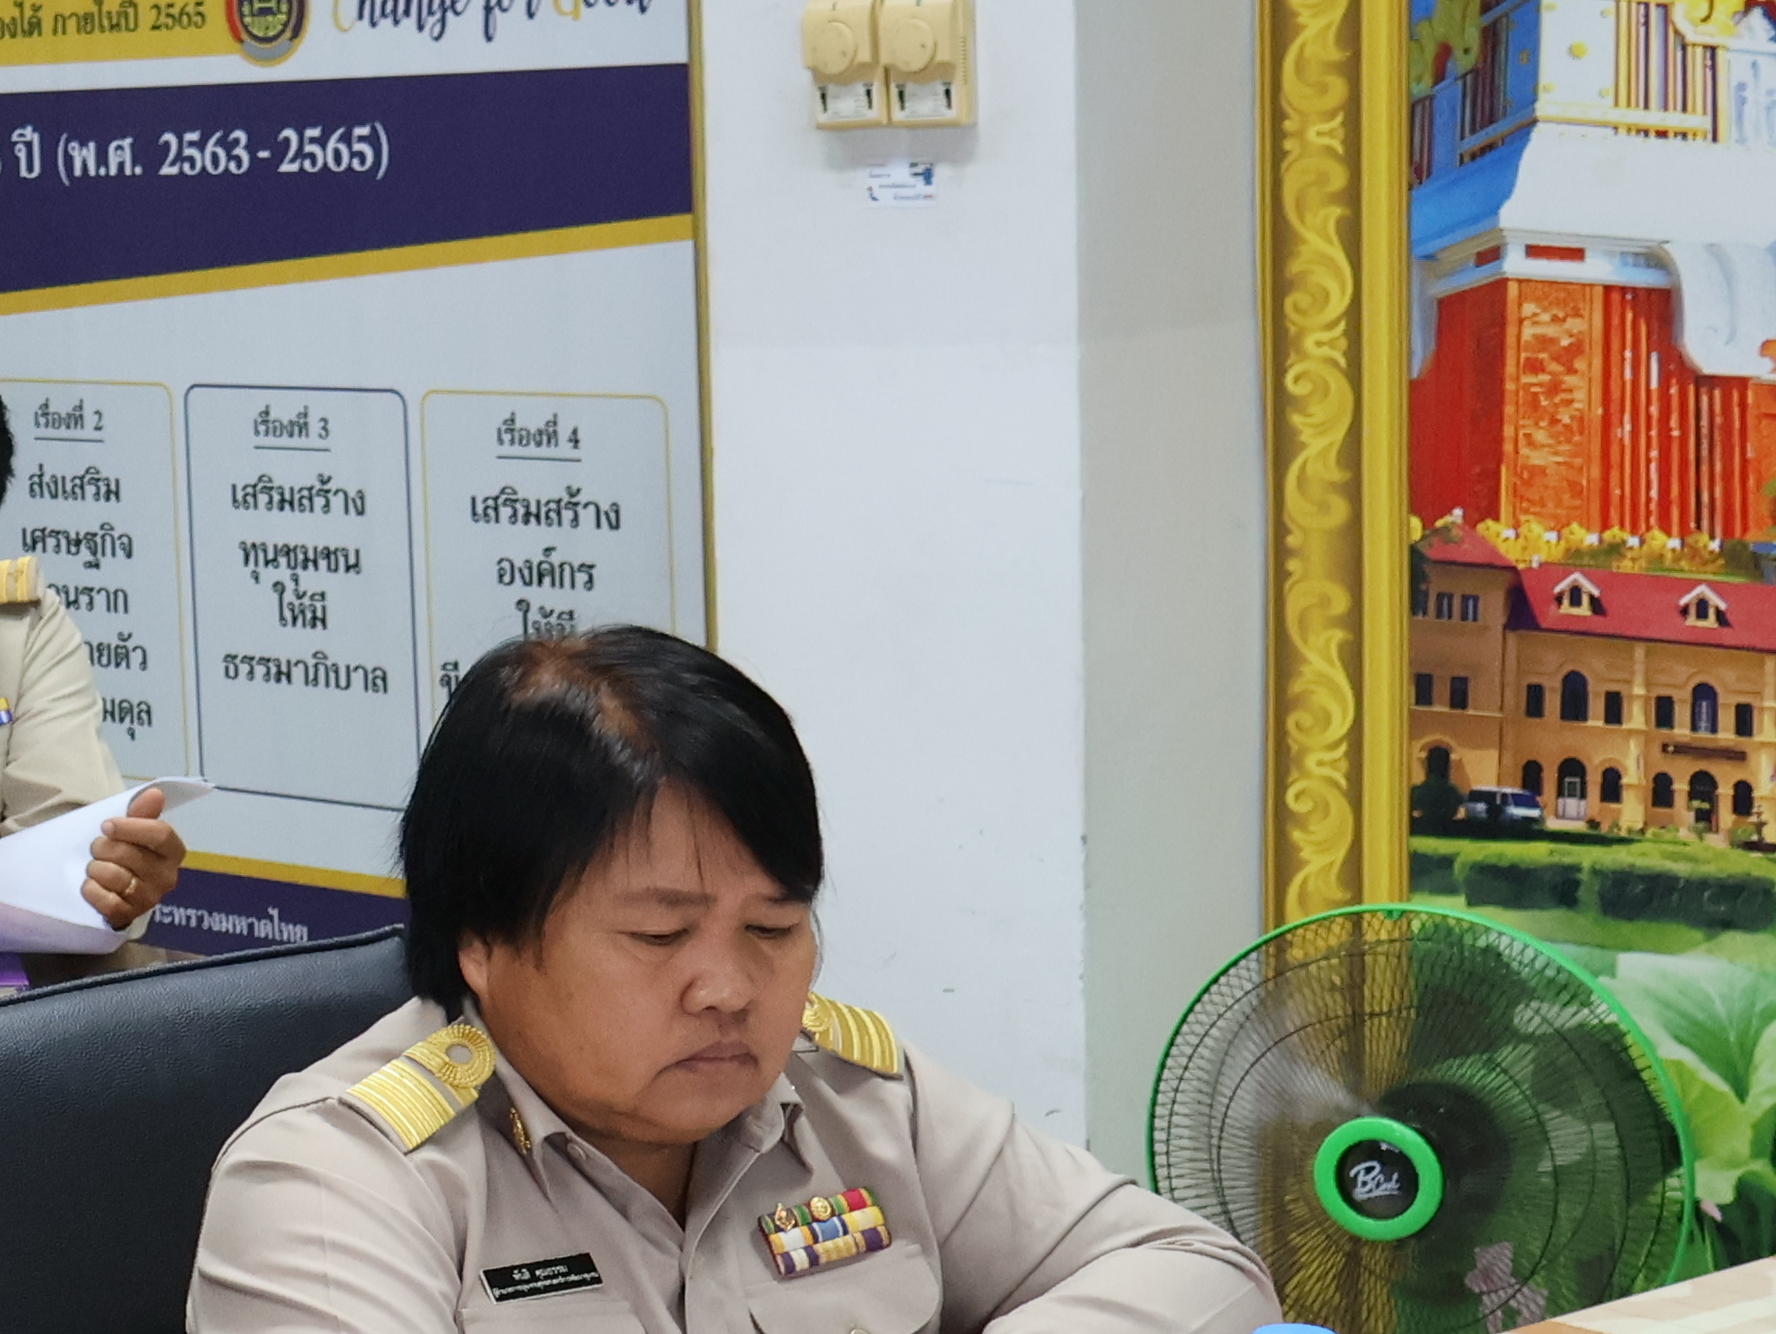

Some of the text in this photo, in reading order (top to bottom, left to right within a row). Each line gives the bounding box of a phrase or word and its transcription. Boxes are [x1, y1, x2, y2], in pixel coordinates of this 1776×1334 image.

[148, 0, 208, 32] 2565
[11, 124, 42, 180] ปี
[56, 132, 143, 186] (พ.ศ.
[34, 397, 104, 432] เรื่องที่ 2
[254, 405, 330, 440] เรื่องที่ 3
[496, 411, 581, 450] เรื่องที่ 4
[28, 463, 121, 504] ส่งเสริม
[231, 473, 366, 517] เสริมสร้าง
[471, 485, 622, 531] เสริมสร้าง
[22, 522, 133, 570] เศรษฐกิจ
[239, 539, 362, 588] ทุนชุมชน
[496, 546, 597, 592] องค์กร
[272, 581, 328, 631] ให้มี
[222, 651, 388, 694] ธรรมาภิบาล
[102, 696, 152, 740] มดุล
[151, 906, 309, 943] ระทรวงมหาดไทย
